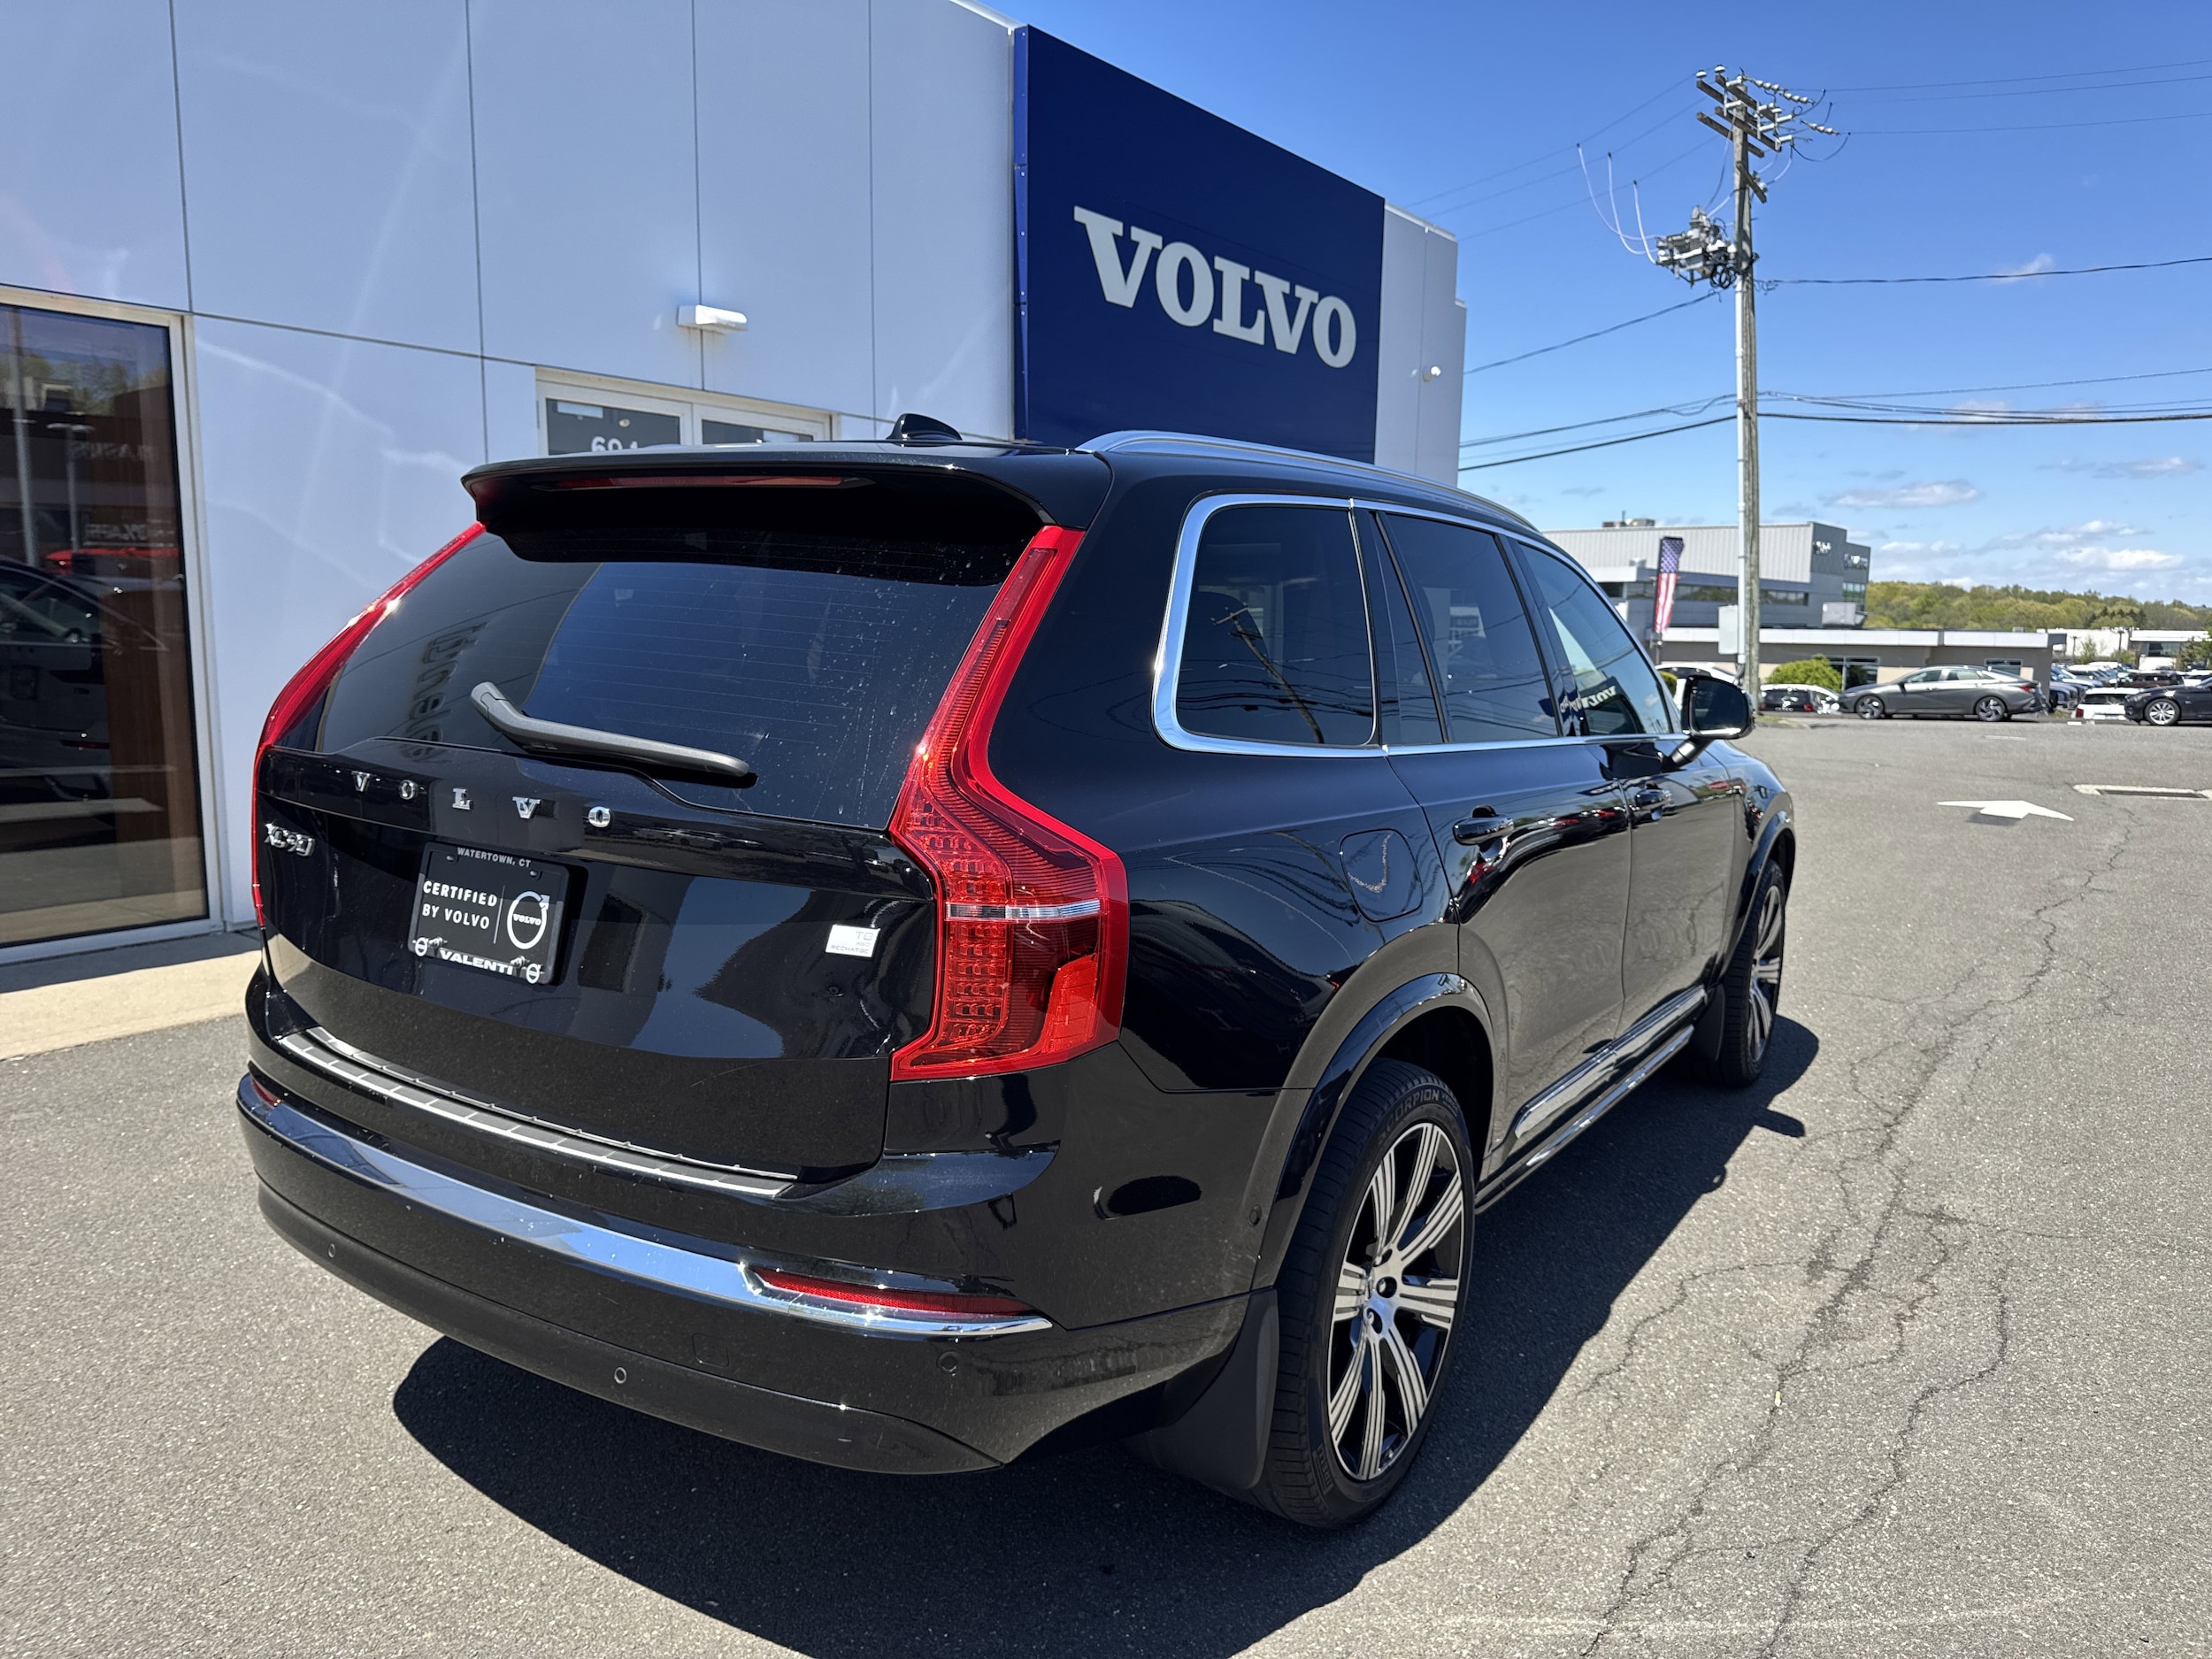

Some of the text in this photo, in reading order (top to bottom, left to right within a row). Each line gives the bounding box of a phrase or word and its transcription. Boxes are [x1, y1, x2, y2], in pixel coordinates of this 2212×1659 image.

[1073, 205, 1356, 368] VOLVO
[352, 771, 612, 828] VOLVO
[264, 823, 315, 856] XC90
[457, 847, 531, 868] WATERTOWN, CT
[423, 879, 497, 908] CERTIFIED
[422, 903, 490, 929] BY VOLVO
[512, 913, 542, 926] VOLVO
[440, 949, 514, 976] VALENTI
